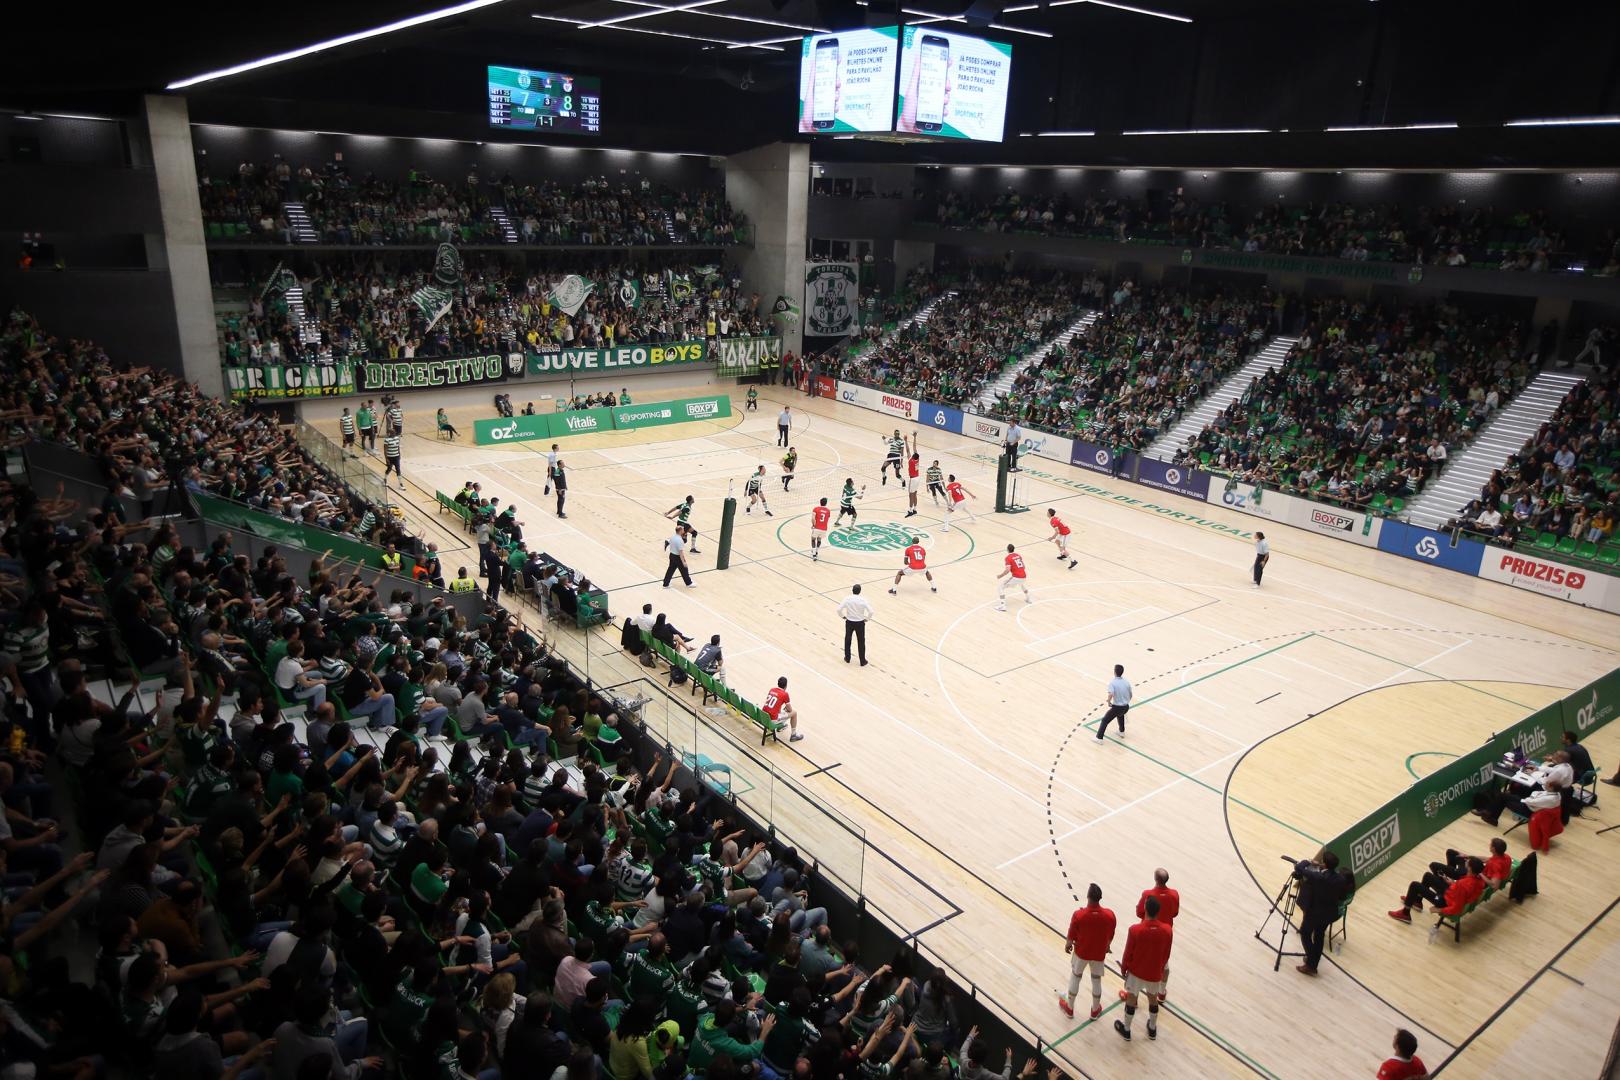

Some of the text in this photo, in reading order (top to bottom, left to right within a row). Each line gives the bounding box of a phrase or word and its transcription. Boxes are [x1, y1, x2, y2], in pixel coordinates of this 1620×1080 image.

[520, 92, 529, 106] 7
[564, 96, 572, 110] 8
[820, 308, 825, 319] 8
[537, 344, 702, 370] JUVE LEO BOYS
[228, 367, 352, 389] BRIGADA
[365, 354, 502, 388] DIRECTIVO
[843, 390, 855, 401] OZ
[882, 396, 905, 409] PROZIS
[689, 403, 716, 414] BOXPT
[567, 416, 597, 428] Vitalis
[630, 412, 661, 420] SPORTING
[491, 427, 513, 440] OZ
[1024, 438, 1041, 452] OZ
[1140, 478, 1162, 488] CAMPEONATO
[1163, 484, 1180, 493] NACIONAL
[1187, 490, 1204, 499] VOLEIBOL
[1223, 490, 1246, 508] OZ
[1054, 476, 1113, 497] CLUBE
[1114, 495, 1142, 505] DE
[1142, 503, 1252, 540] PORTUGAL
[820, 513, 826, 522] 3
[1314, 512, 1350, 528] BOXPT
[914, 552, 922, 560] 16
[1500, 555, 1565, 585] PROZIS
[698, 651, 707, 660] 7
[766, 695, 778, 708] 20
[1577, 702, 1596, 730] OZ
[1512, 725, 1546, 756] Vitalis
[1438, 762, 1493, 807] SPORTING TV
[1354, 820, 1394, 866] BOXPT
